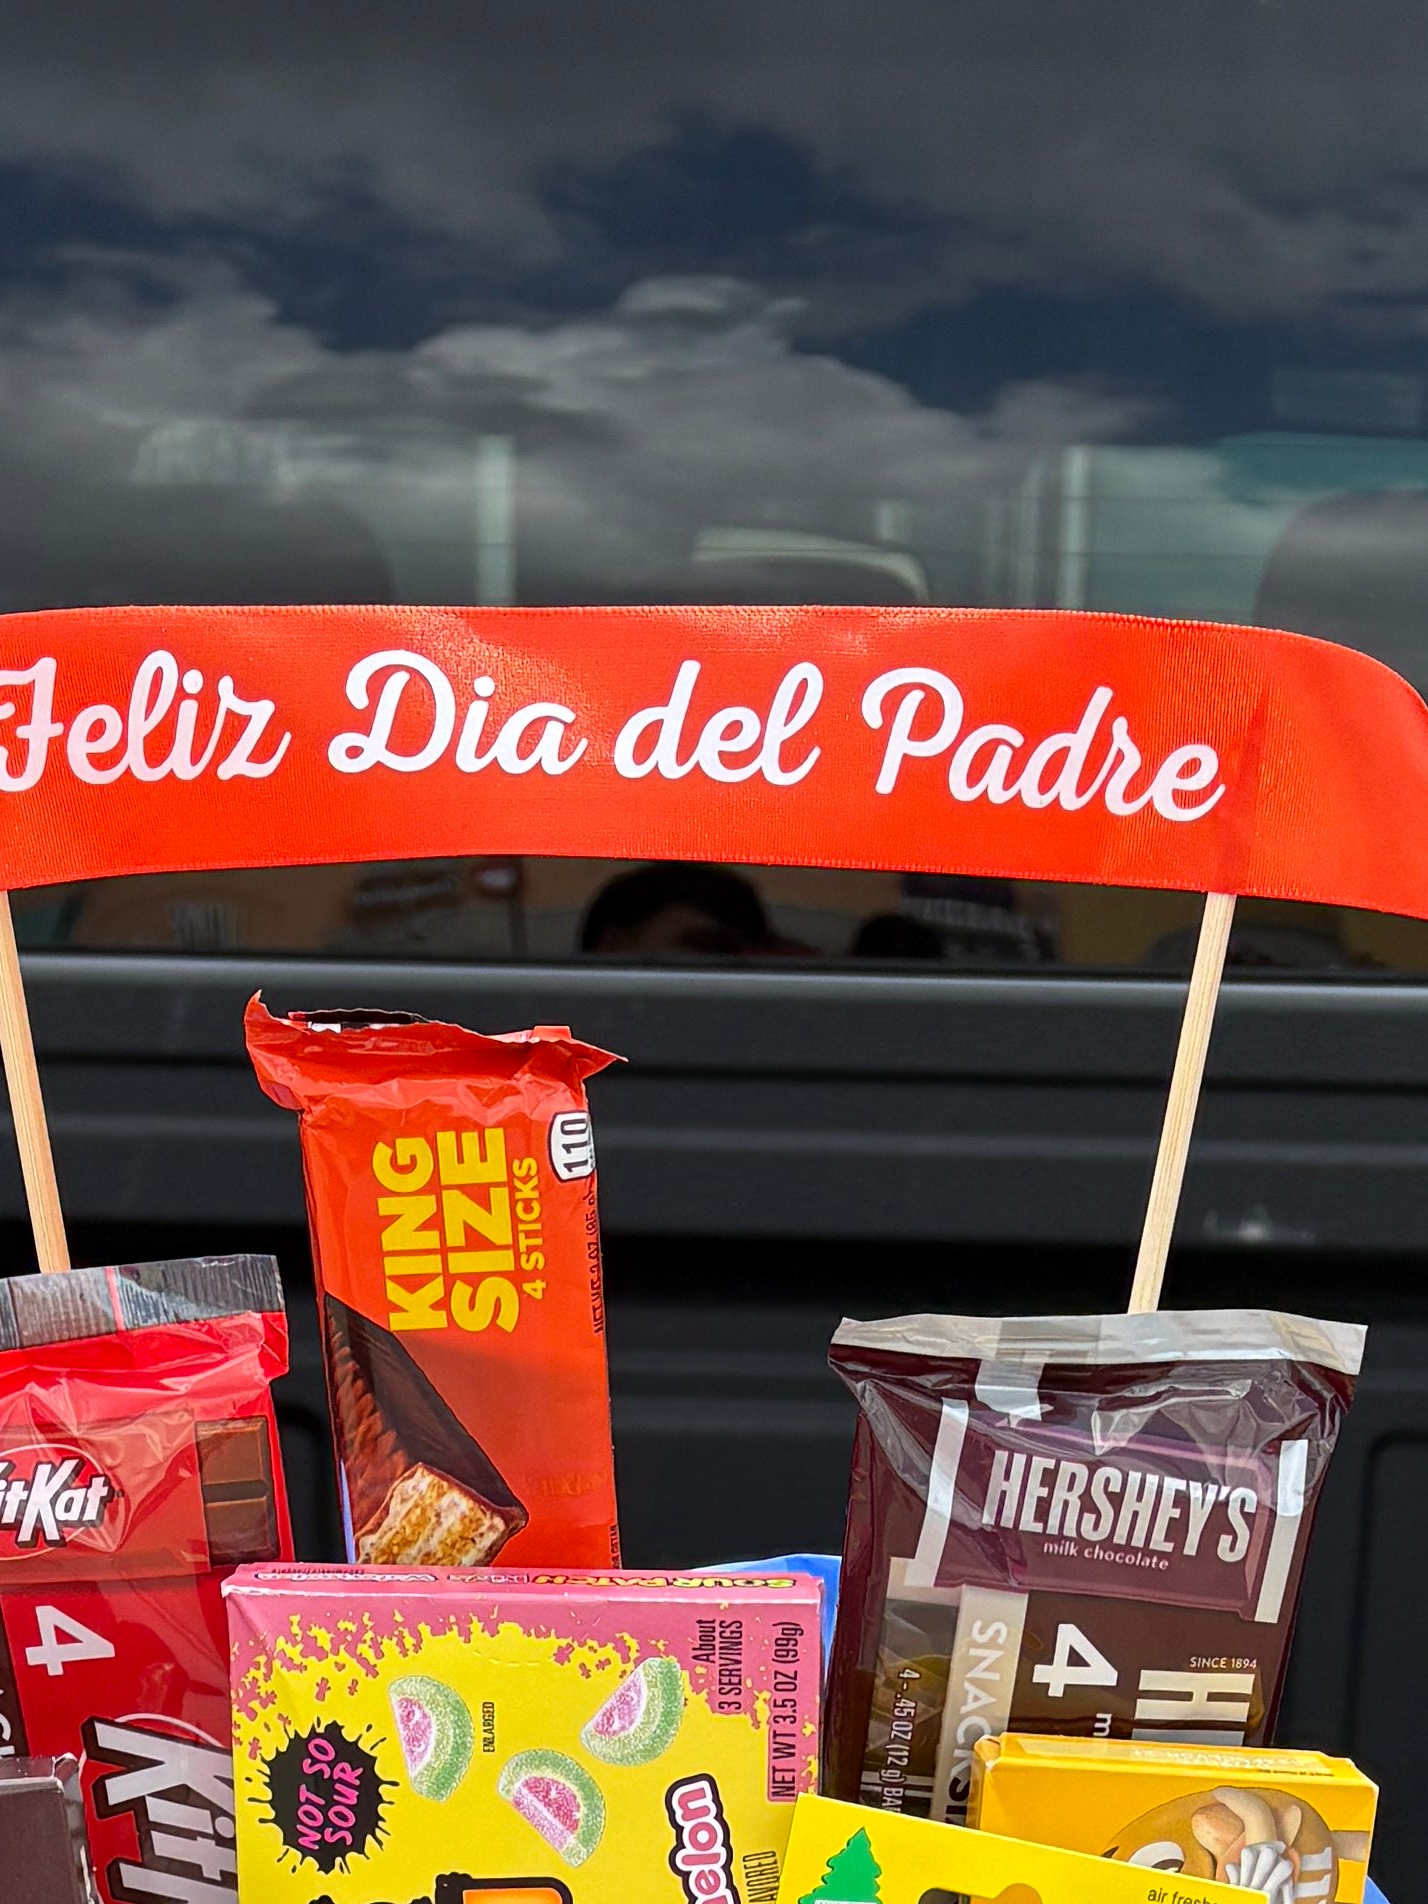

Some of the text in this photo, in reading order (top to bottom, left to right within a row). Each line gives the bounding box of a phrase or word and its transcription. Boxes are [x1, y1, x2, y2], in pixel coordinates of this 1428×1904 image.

[329, 649, 586, 777] Dia
[615, 660, 820, 785] del
[863, 666, 1225, 823] Padre
[561, 1118, 589, 1173] 110
[373, 1137, 448, 1332] KING
[437, 1128, 520, 1333] SIZE
[514, 1157, 546, 1300] 4 STICKS
[981, 1450, 1258, 1563] HERSHEY'S
[1043, 1541, 1169, 1572] milk chocolate
[25, 1605, 115, 1676] 4
[692, 1620, 716, 1664] About
[718, 1619, 743, 1711] 3 SERVINGS
[1032, 1623, 1119, 1697] 4
[1189, 1655, 1258, 1670] SINCE 1894
[771, 1621, 803, 1798] NET WT 3.5 OZ (99g)
[890, 1721, 914, 1741] OZ
[297, 1737, 335, 1851] NOT SO
[322, 1764, 363, 1845] SOUR
[1147, 1886, 1169, 1904] air
